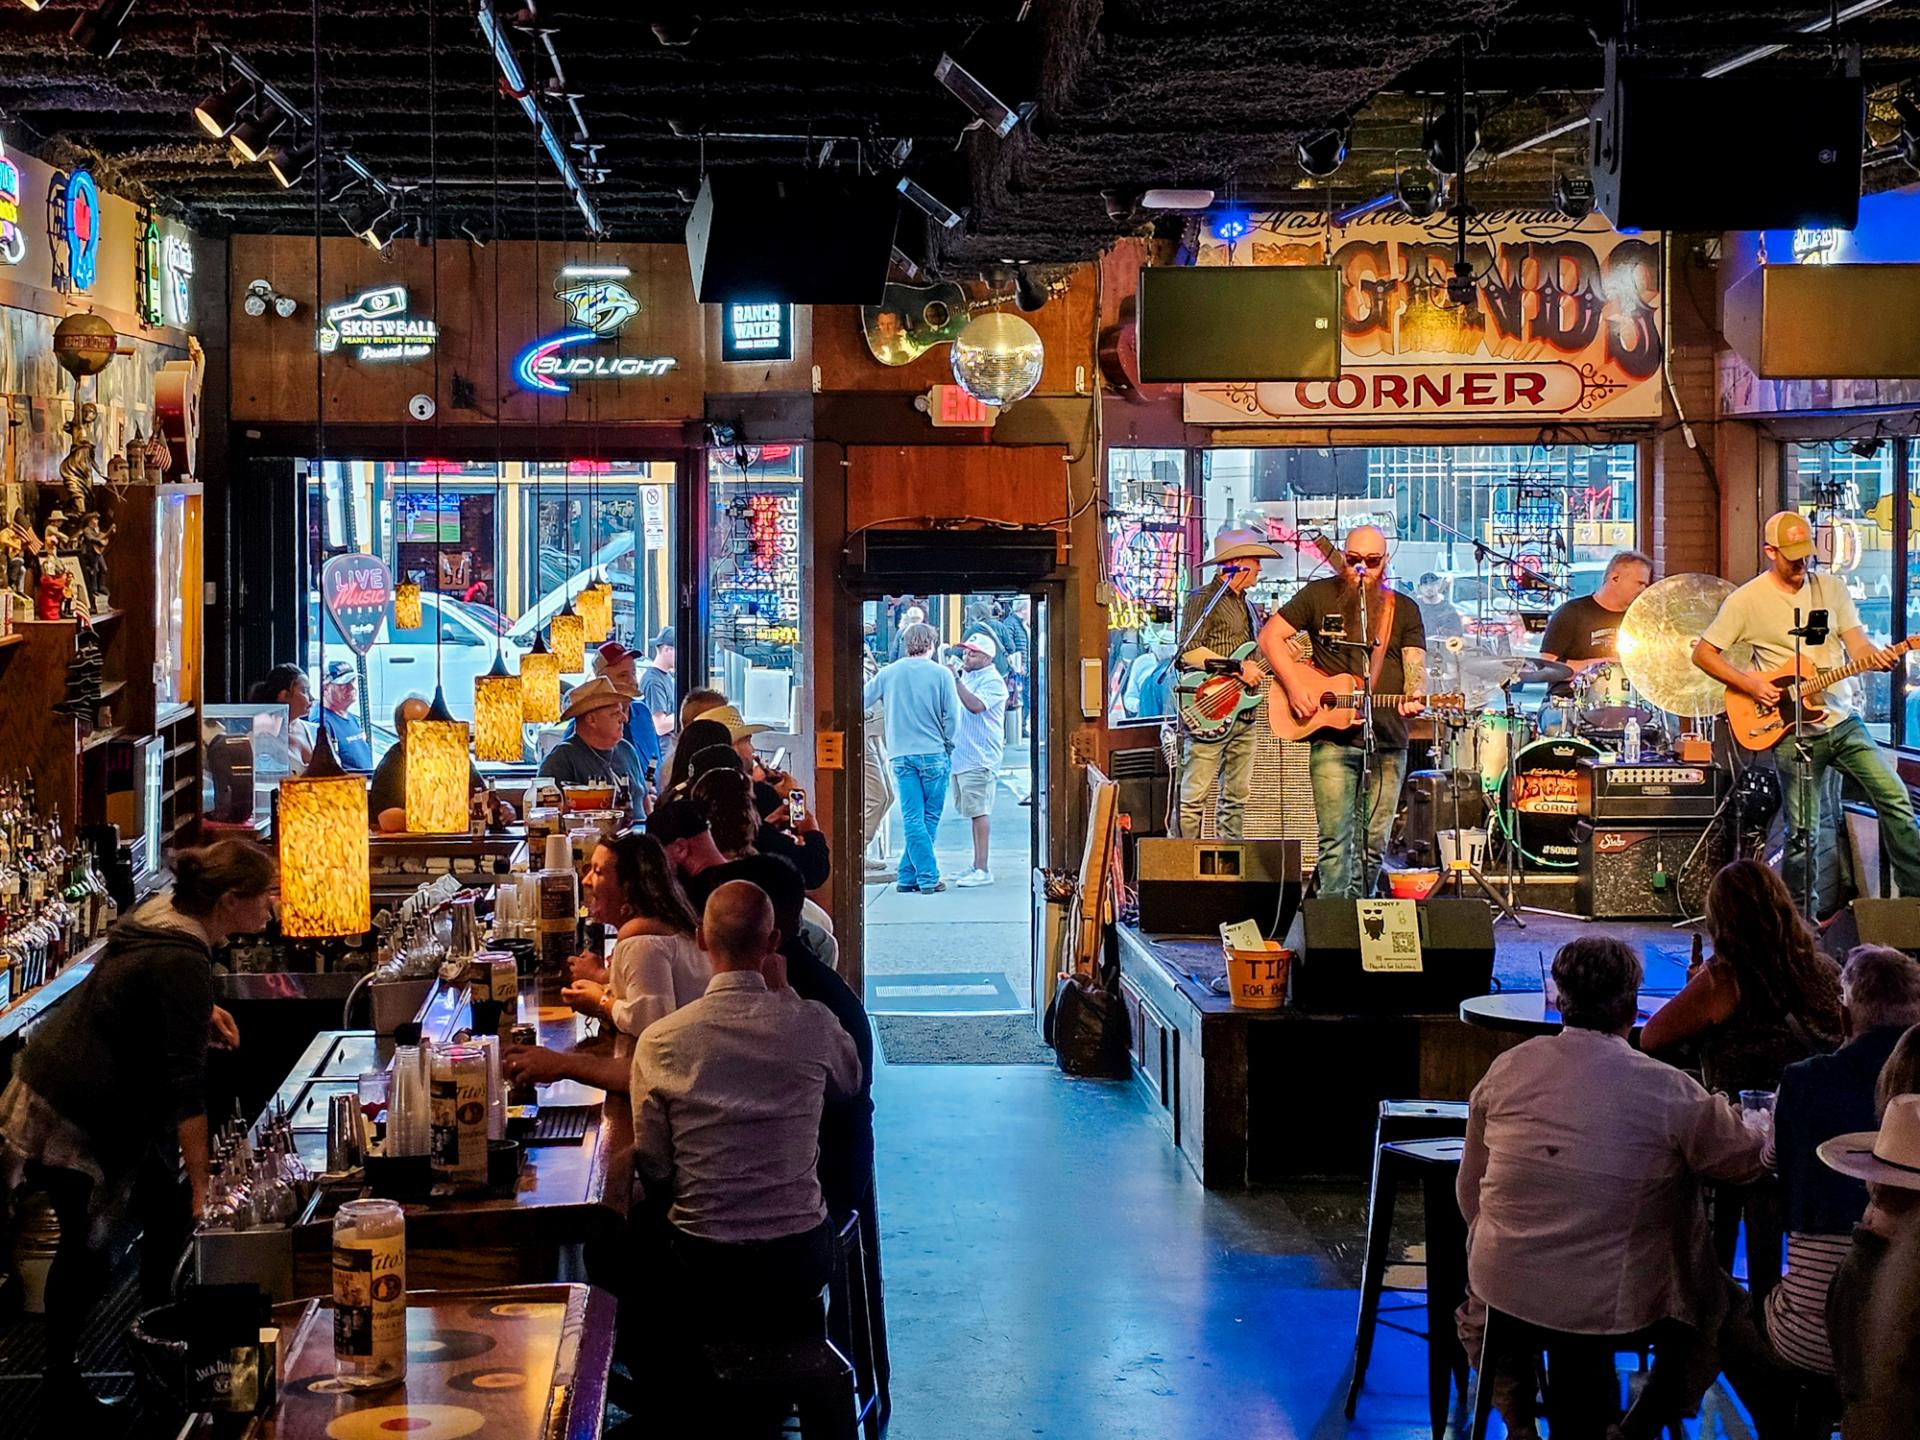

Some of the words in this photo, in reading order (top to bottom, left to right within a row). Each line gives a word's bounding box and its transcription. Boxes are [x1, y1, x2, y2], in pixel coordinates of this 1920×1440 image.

[733, 303, 780, 321] RANCH
[1200, 239, 1662, 382] GENDS
[341, 320, 436, 337] SKREWBALL
[734, 321, 780, 339] WATER
[342, 336, 372, 344] PEANUT
[373, 336, 402, 344] BUTTER
[534, 356, 593, 375] BUD
[595, 356, 677, 375] LIGHT
[1295, 370, 1547, 410] CORNER
[334, 567, 384, 592] LIVE
[1242, 983, 1265, 997] FOR
